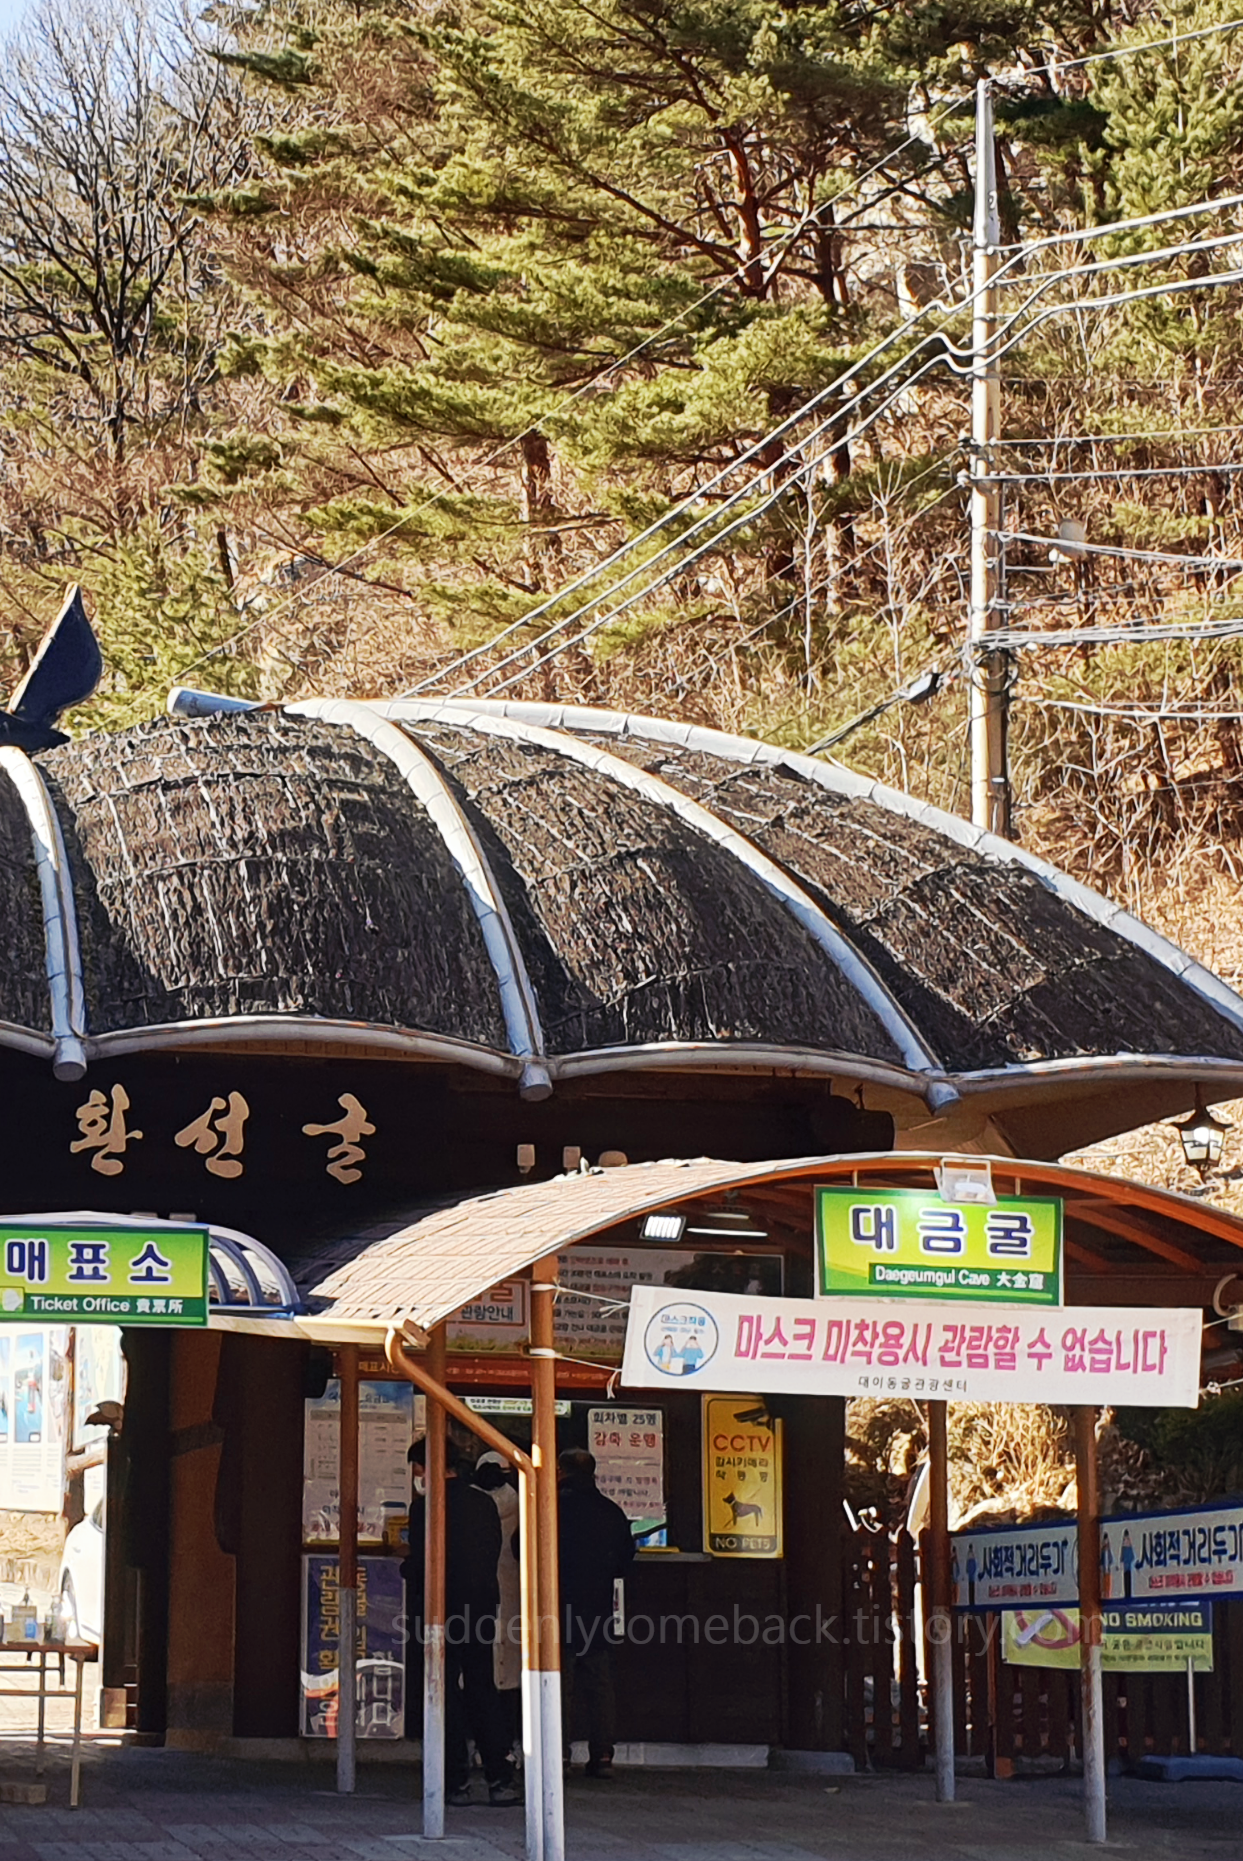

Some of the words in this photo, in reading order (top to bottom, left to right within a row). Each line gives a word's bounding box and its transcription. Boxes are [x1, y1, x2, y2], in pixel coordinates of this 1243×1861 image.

[851, 1206, 1033, 1256] 대금굴
[6, 1240, 171, 1283] 매표소
[874, 1264, 956, 1287] Daegeumgul
[958, 1269, 991, 1286] Cave
[30, 1295, 78, 1312] Ticket
[82, 1296, 131, 1313] Office
[460, 1305, 514, 1322] 관람안내
[733, 1313, 817, 1362] 마스크
[821, 1318, 932, 1367] 미착용시
[937, 1323, 1021, 1371] 관람할
[1026, 1326, 1053, 1372] 수
[1060, 1326, 1169, 1376] 없습니다
[712, 1434, 771, 1452] CCTV
[715, 1456, 769, 1469] 감시카메라
[715, 1537, 737, 1550] NO
[741, 1537, 772, 1551] PETS
[1101, 1611, 1121, 1627] NO
[1125, 1611, 1204, 1628] SMOKING
